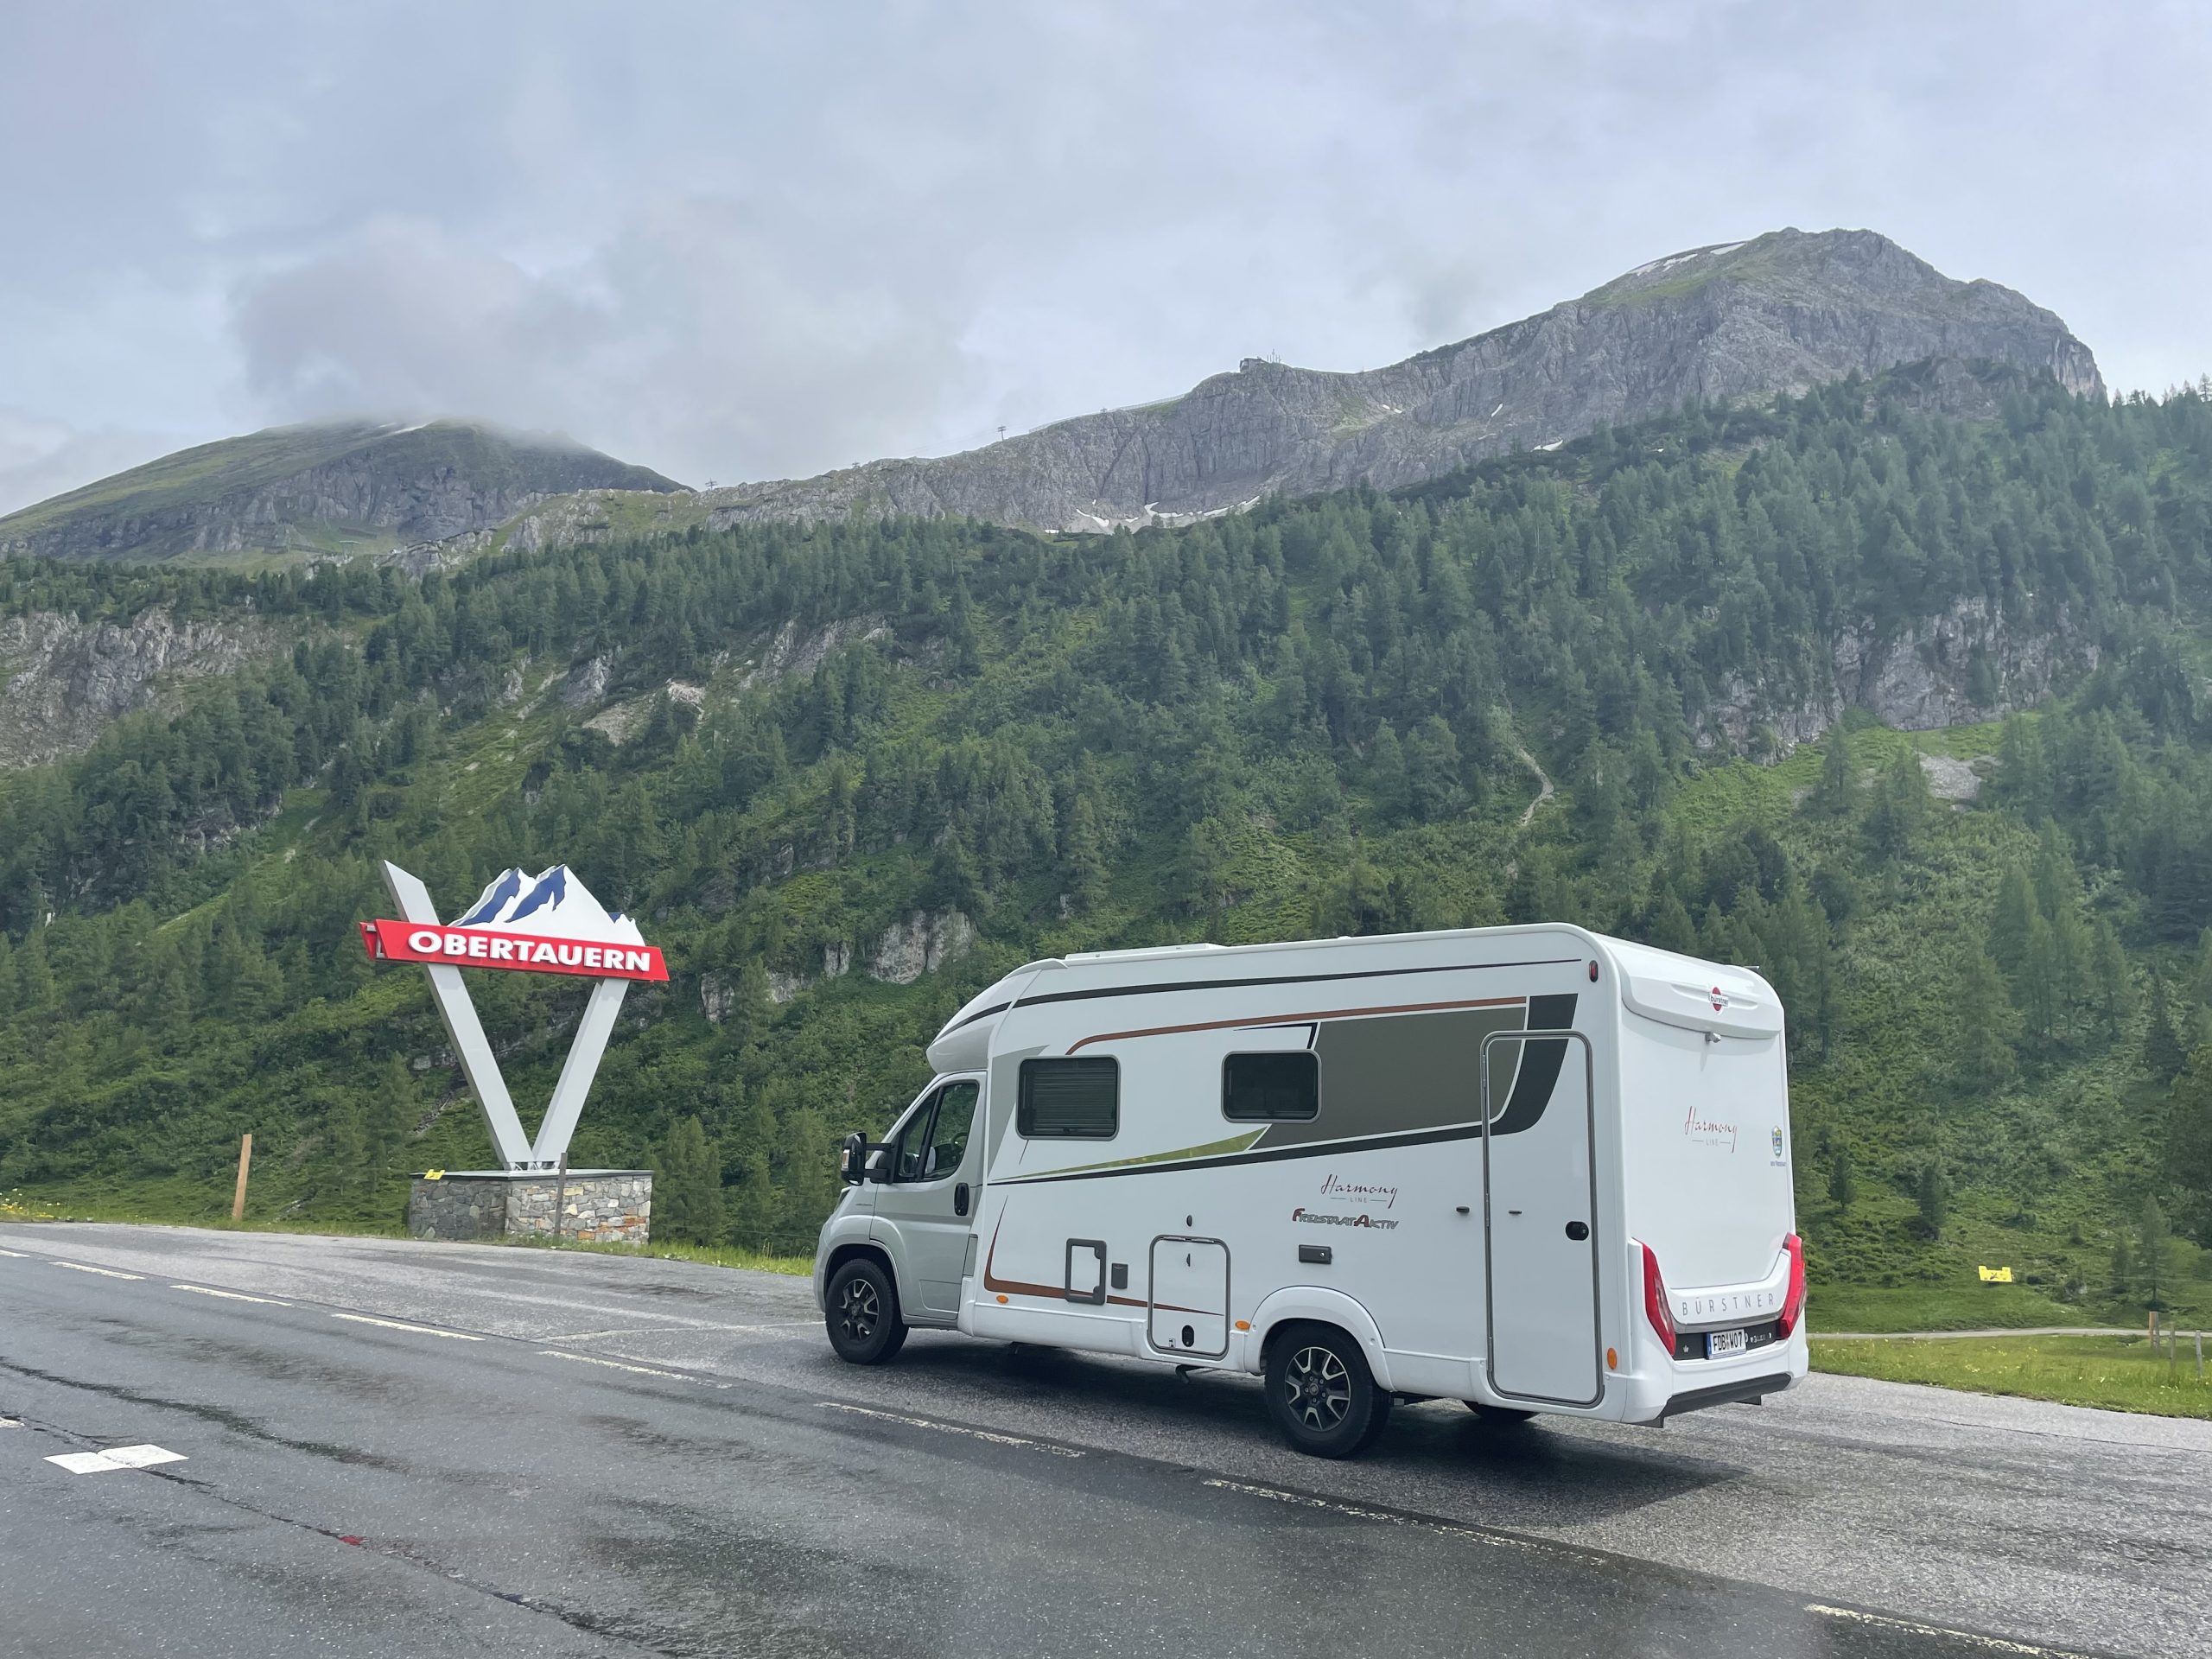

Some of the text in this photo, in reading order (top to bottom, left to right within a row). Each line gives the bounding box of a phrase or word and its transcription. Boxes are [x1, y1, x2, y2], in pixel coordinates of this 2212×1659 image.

[408, 931, 651, 972] OBERTAUERN
[1684, 1106, 1737, 1154] Harmony
[1320, 1173, 1398, 1209] Harmony
[1681, 1293, 1774, 1316] BÜRSTNER
